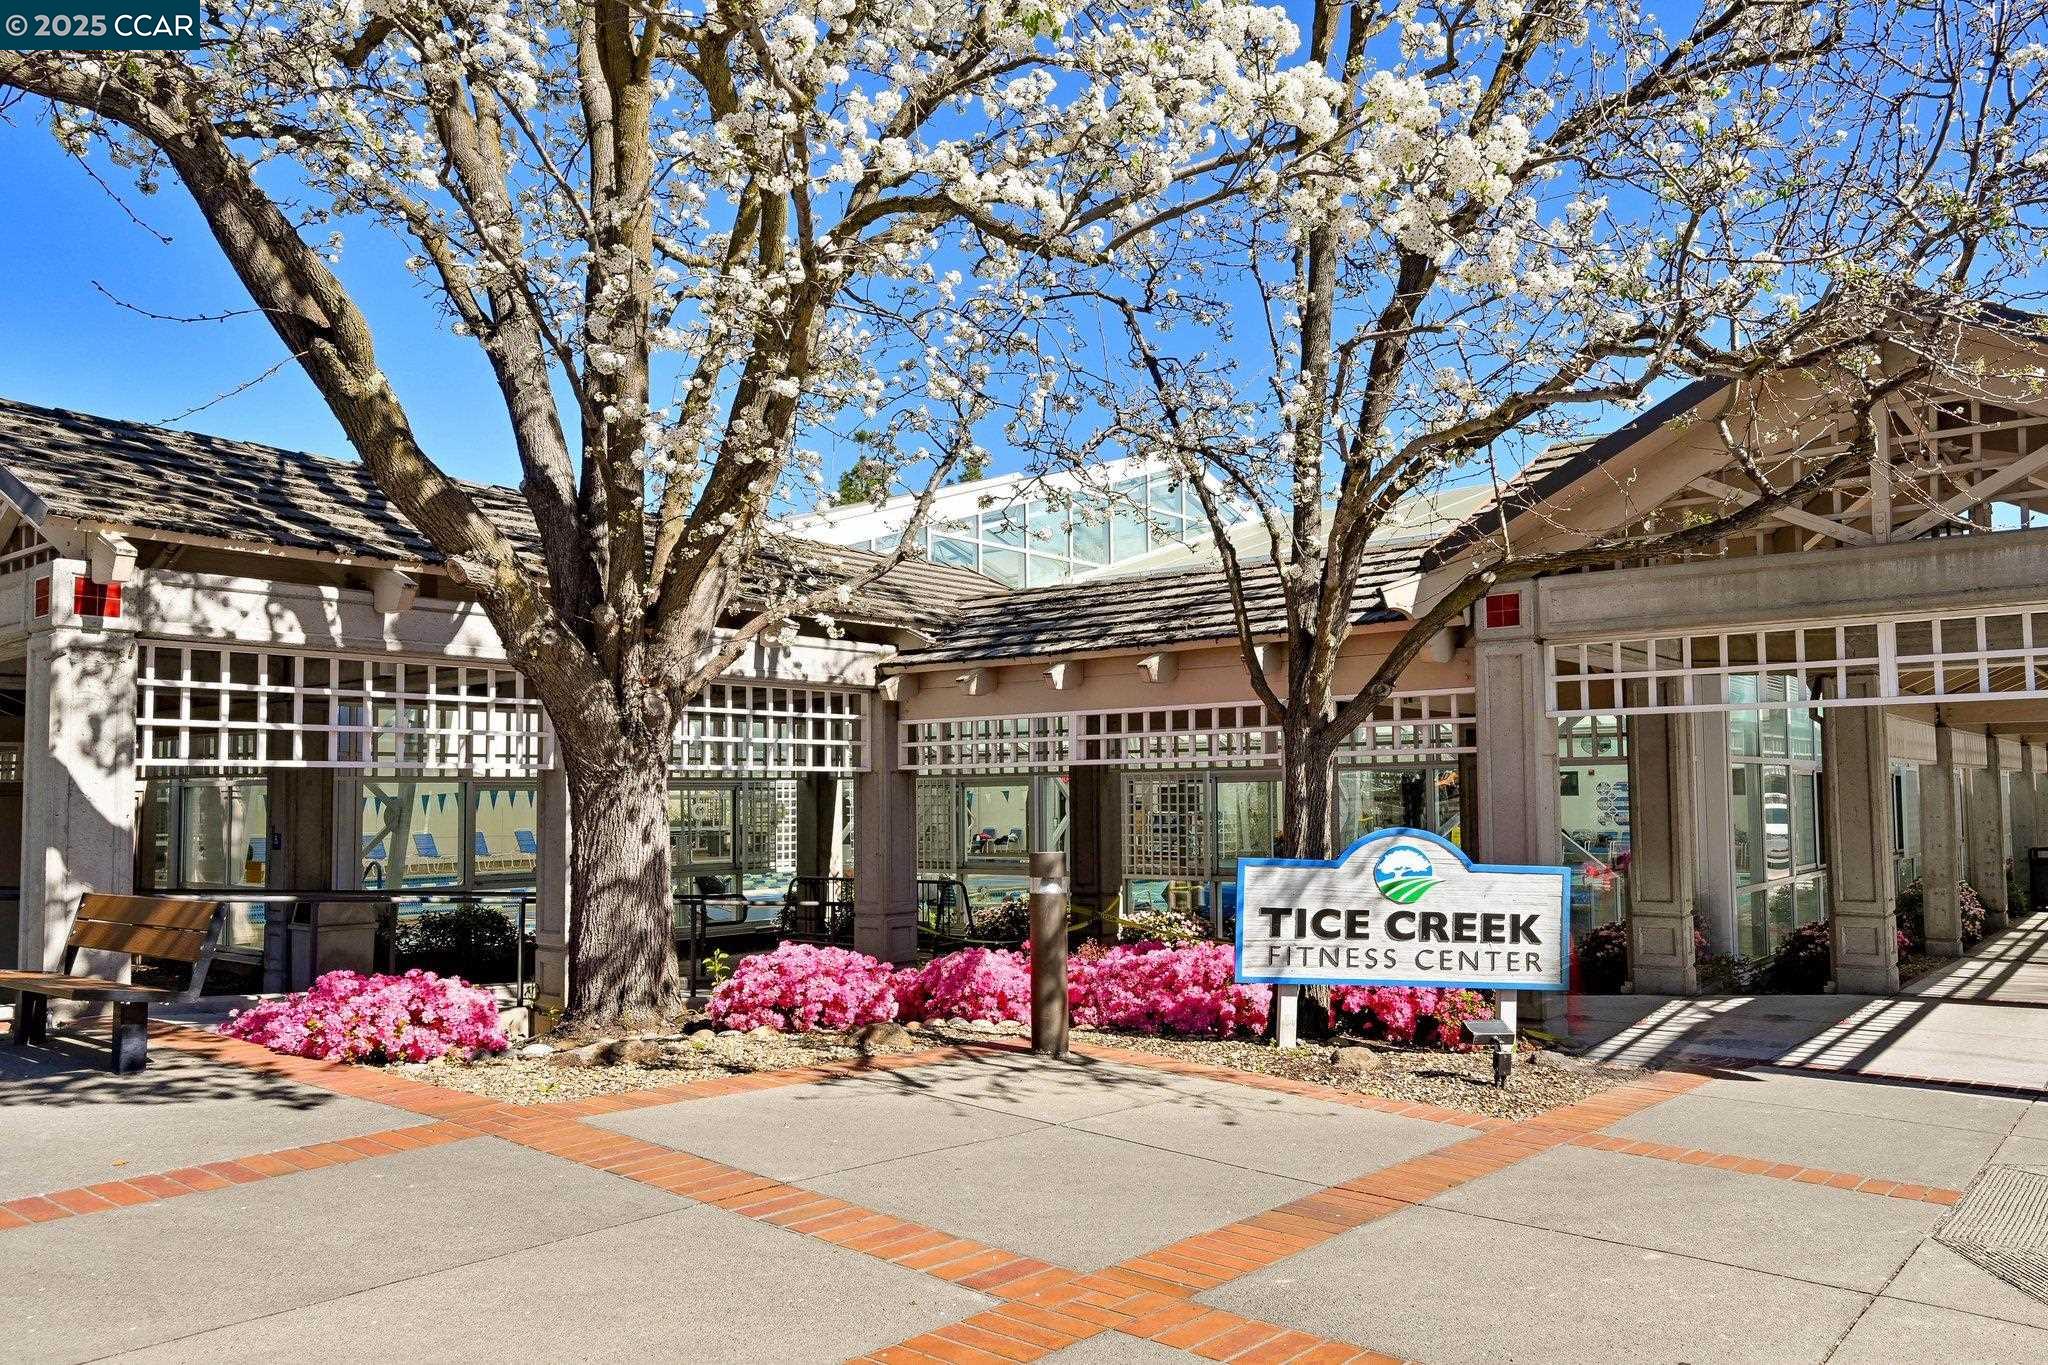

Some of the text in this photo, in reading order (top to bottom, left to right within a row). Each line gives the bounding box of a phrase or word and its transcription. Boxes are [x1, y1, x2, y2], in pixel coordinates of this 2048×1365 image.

[1259, 907, 1542, 945] TICE CREEK
[1267, 945, 1543, 972] FITNESS CENTER
